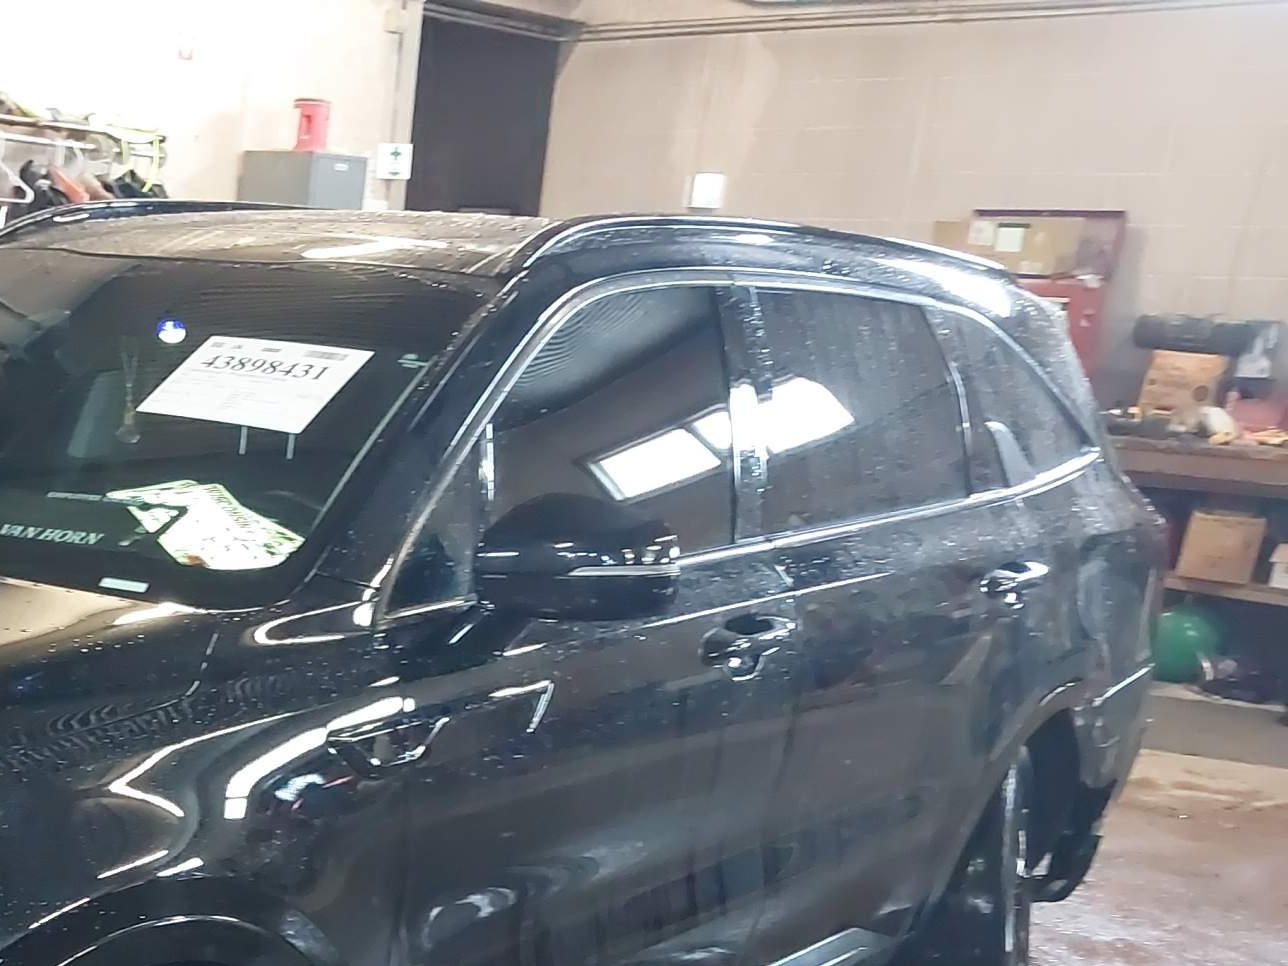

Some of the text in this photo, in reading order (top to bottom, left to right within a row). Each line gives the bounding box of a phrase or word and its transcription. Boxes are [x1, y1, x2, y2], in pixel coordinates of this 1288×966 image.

[200, 354, 330, 381] 43898431
[0, 523, 105, 545] VAN HORN
